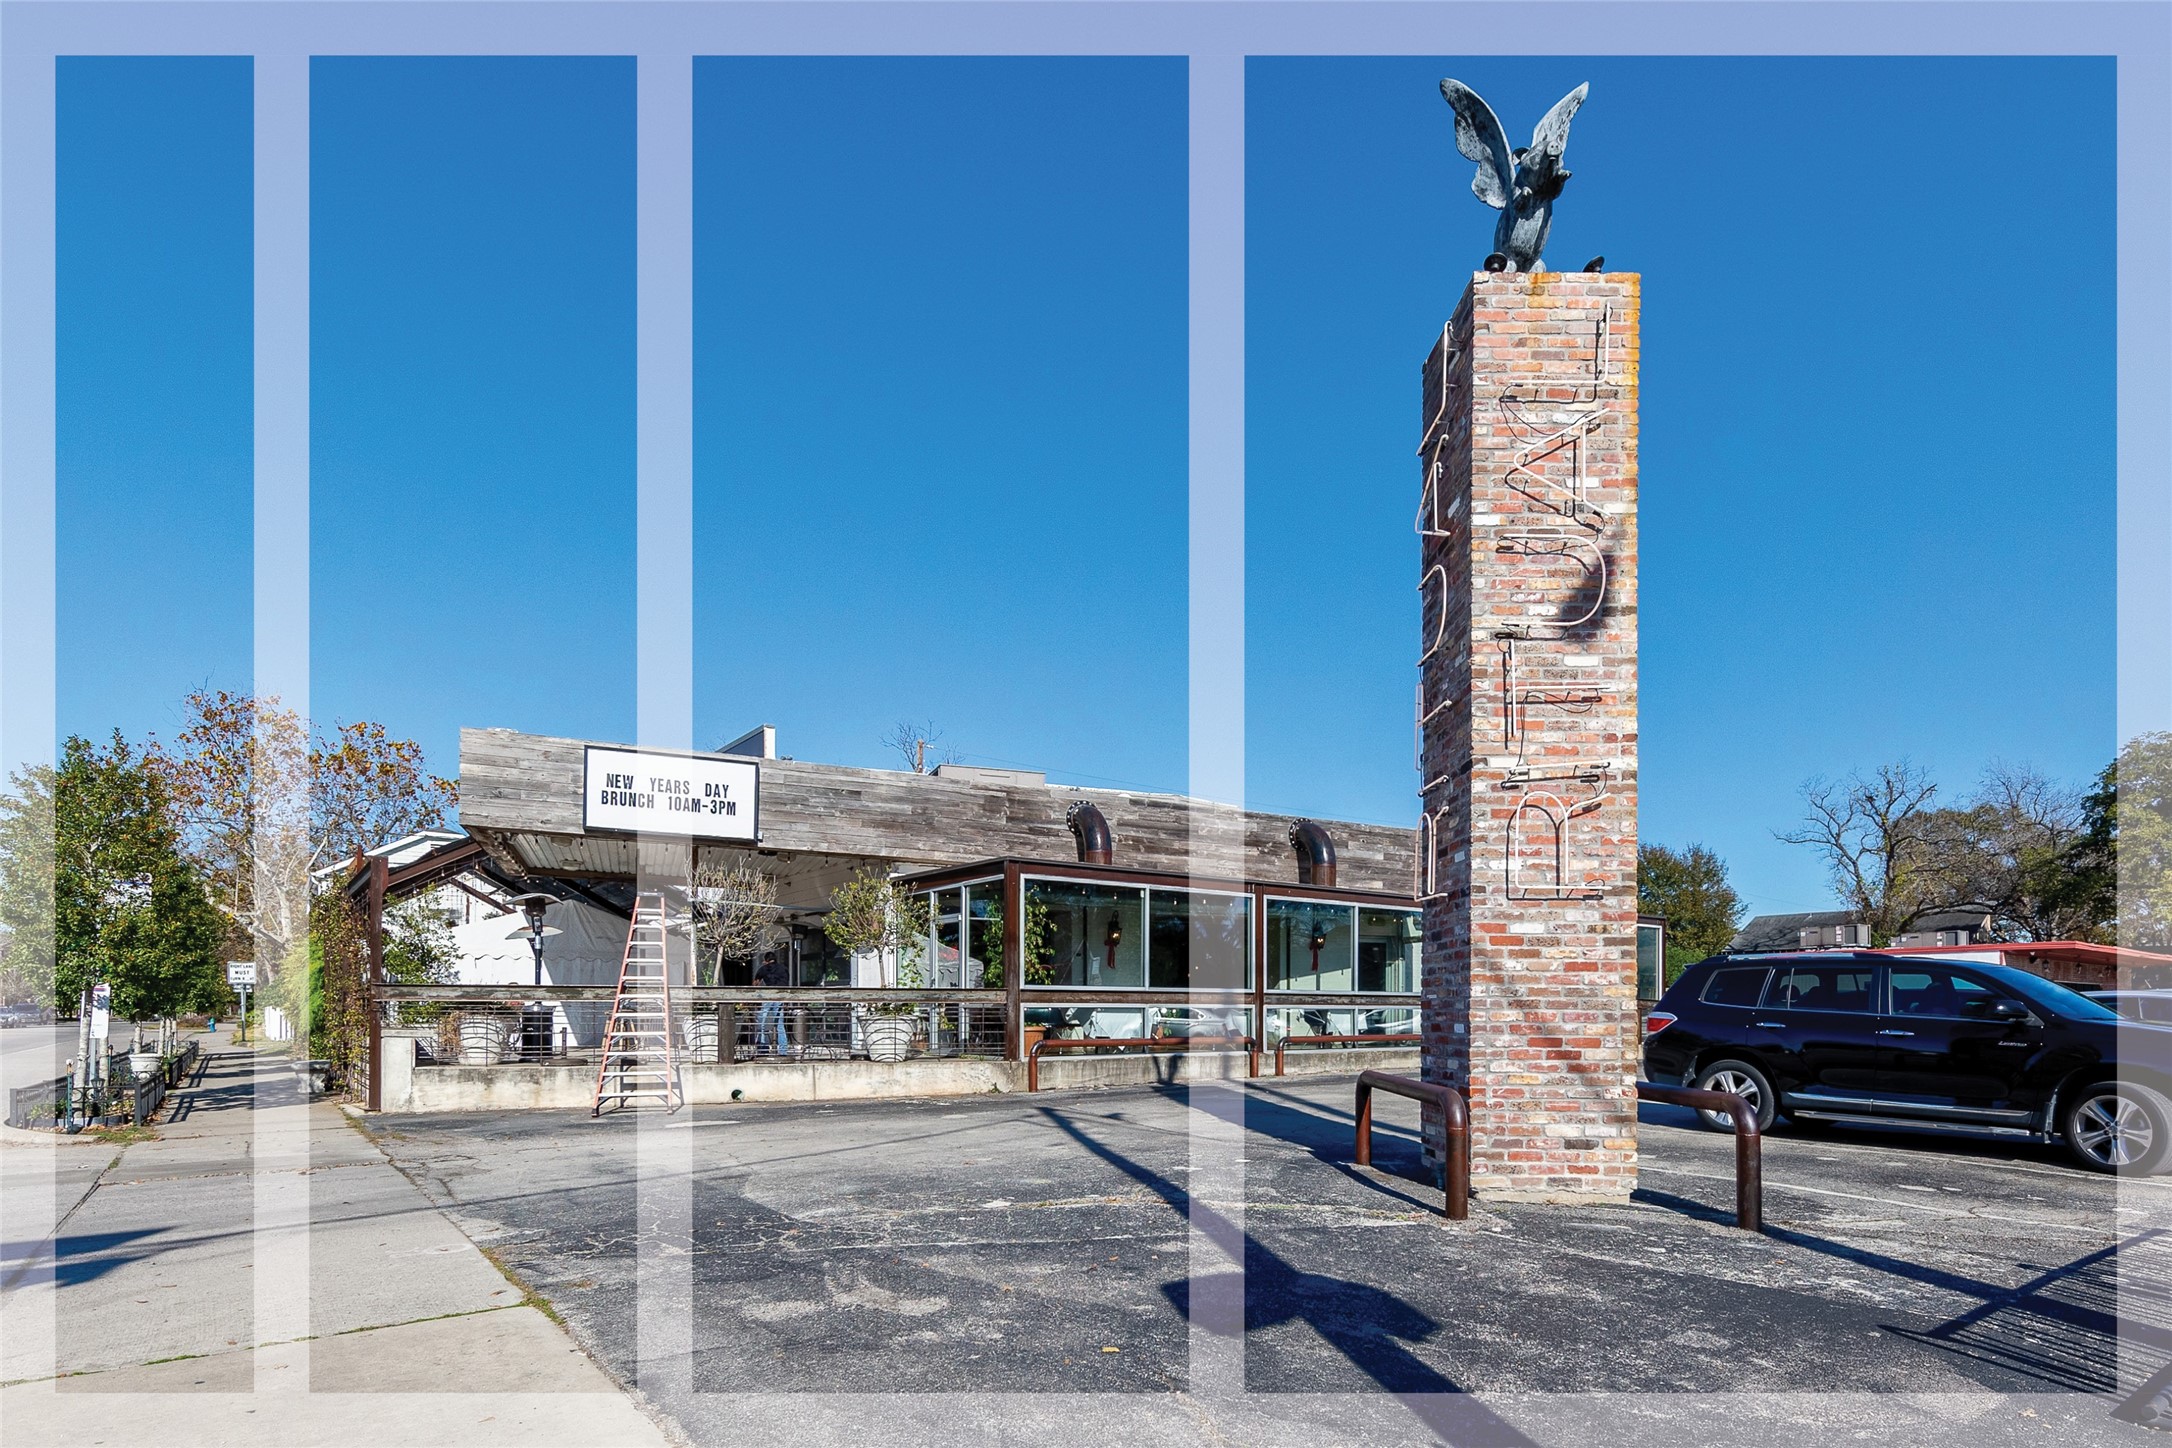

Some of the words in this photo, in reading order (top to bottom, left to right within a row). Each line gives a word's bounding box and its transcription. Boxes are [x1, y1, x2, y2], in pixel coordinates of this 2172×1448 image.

[1501, 301, 1612, 891] RITUAL
[606, 773, 634, 790] NEW
[649, 777, 690, 795] YEARS
[704, 783, 729, 799] DAY
[601, 790, 655, 809] BRUNCH
[668, 796, 737, 816] 10AM-3PM
